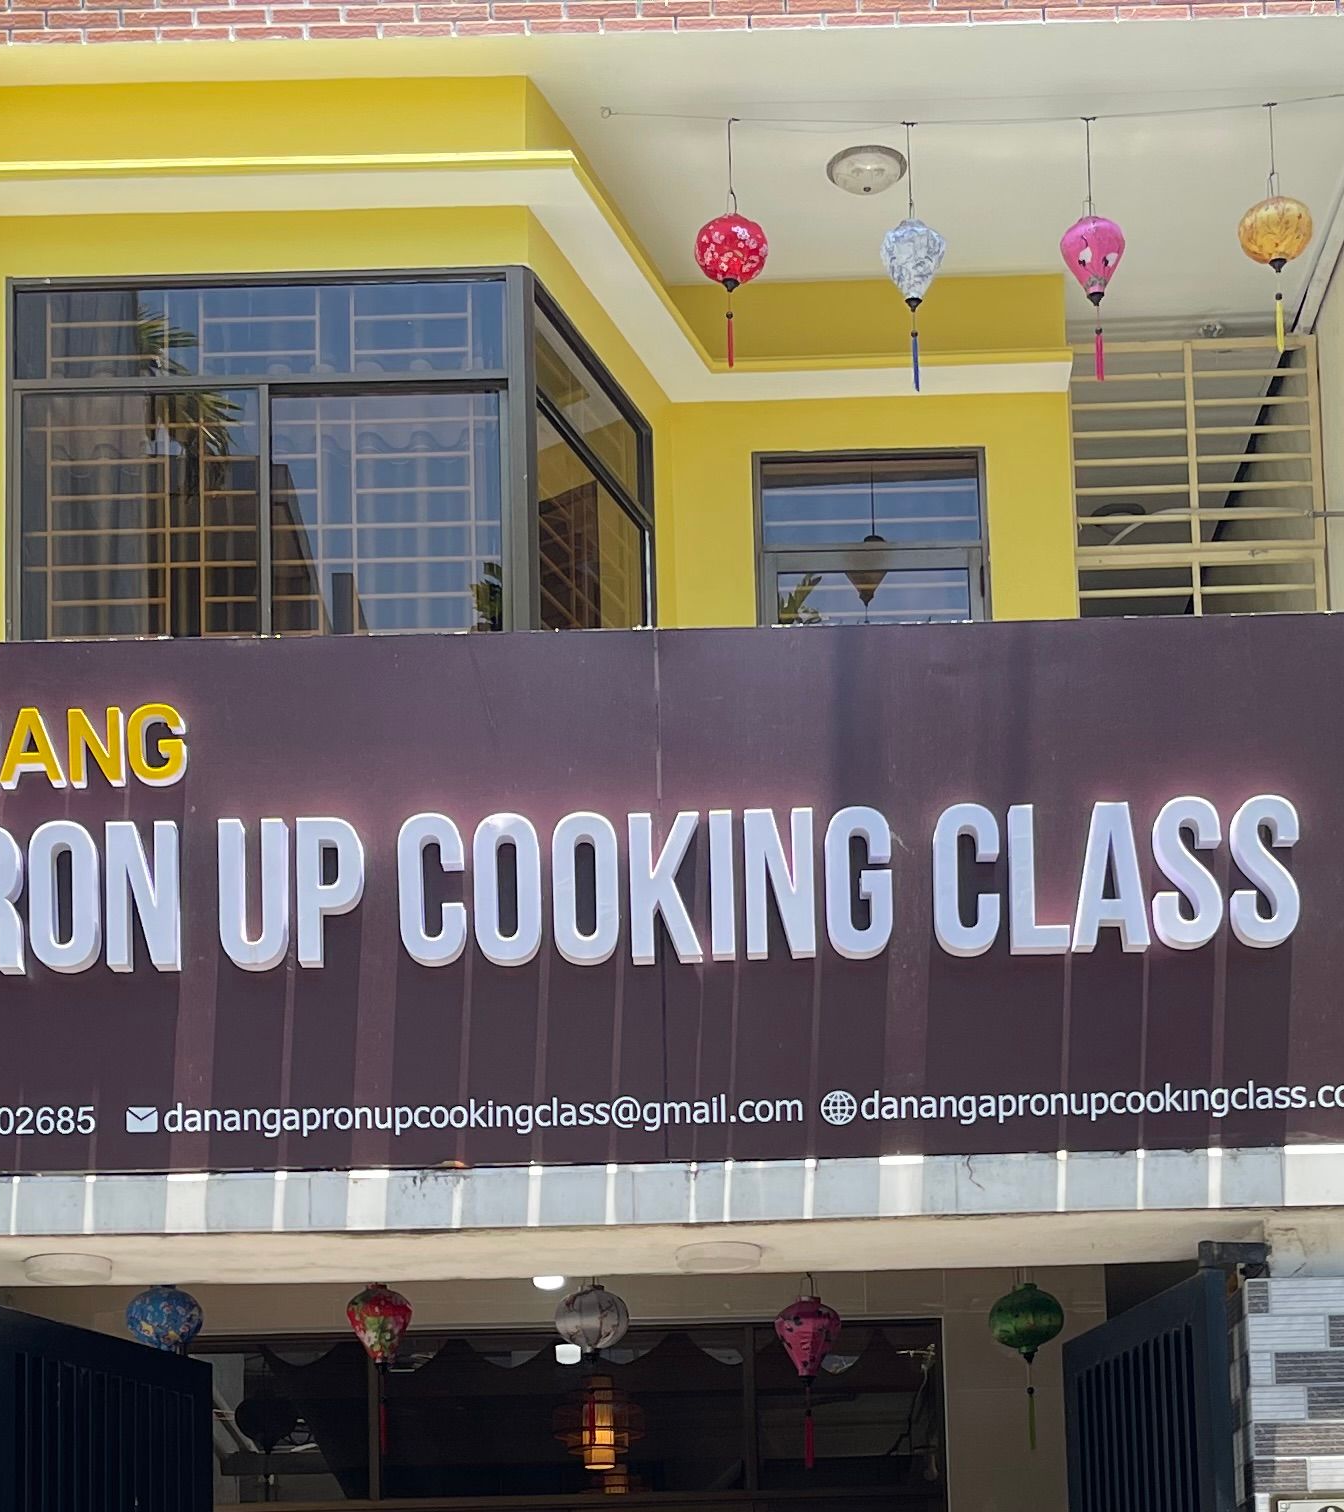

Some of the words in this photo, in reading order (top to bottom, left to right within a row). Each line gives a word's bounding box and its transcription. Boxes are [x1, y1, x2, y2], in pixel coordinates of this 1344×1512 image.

[218, 813, 365, 971] UP
[397, 806, 894, 968] COOKING
[933, 795, 1300, 958] CLASS
[163, 1093, 804, 1138] danangapronupcookingclass@gmail.com
